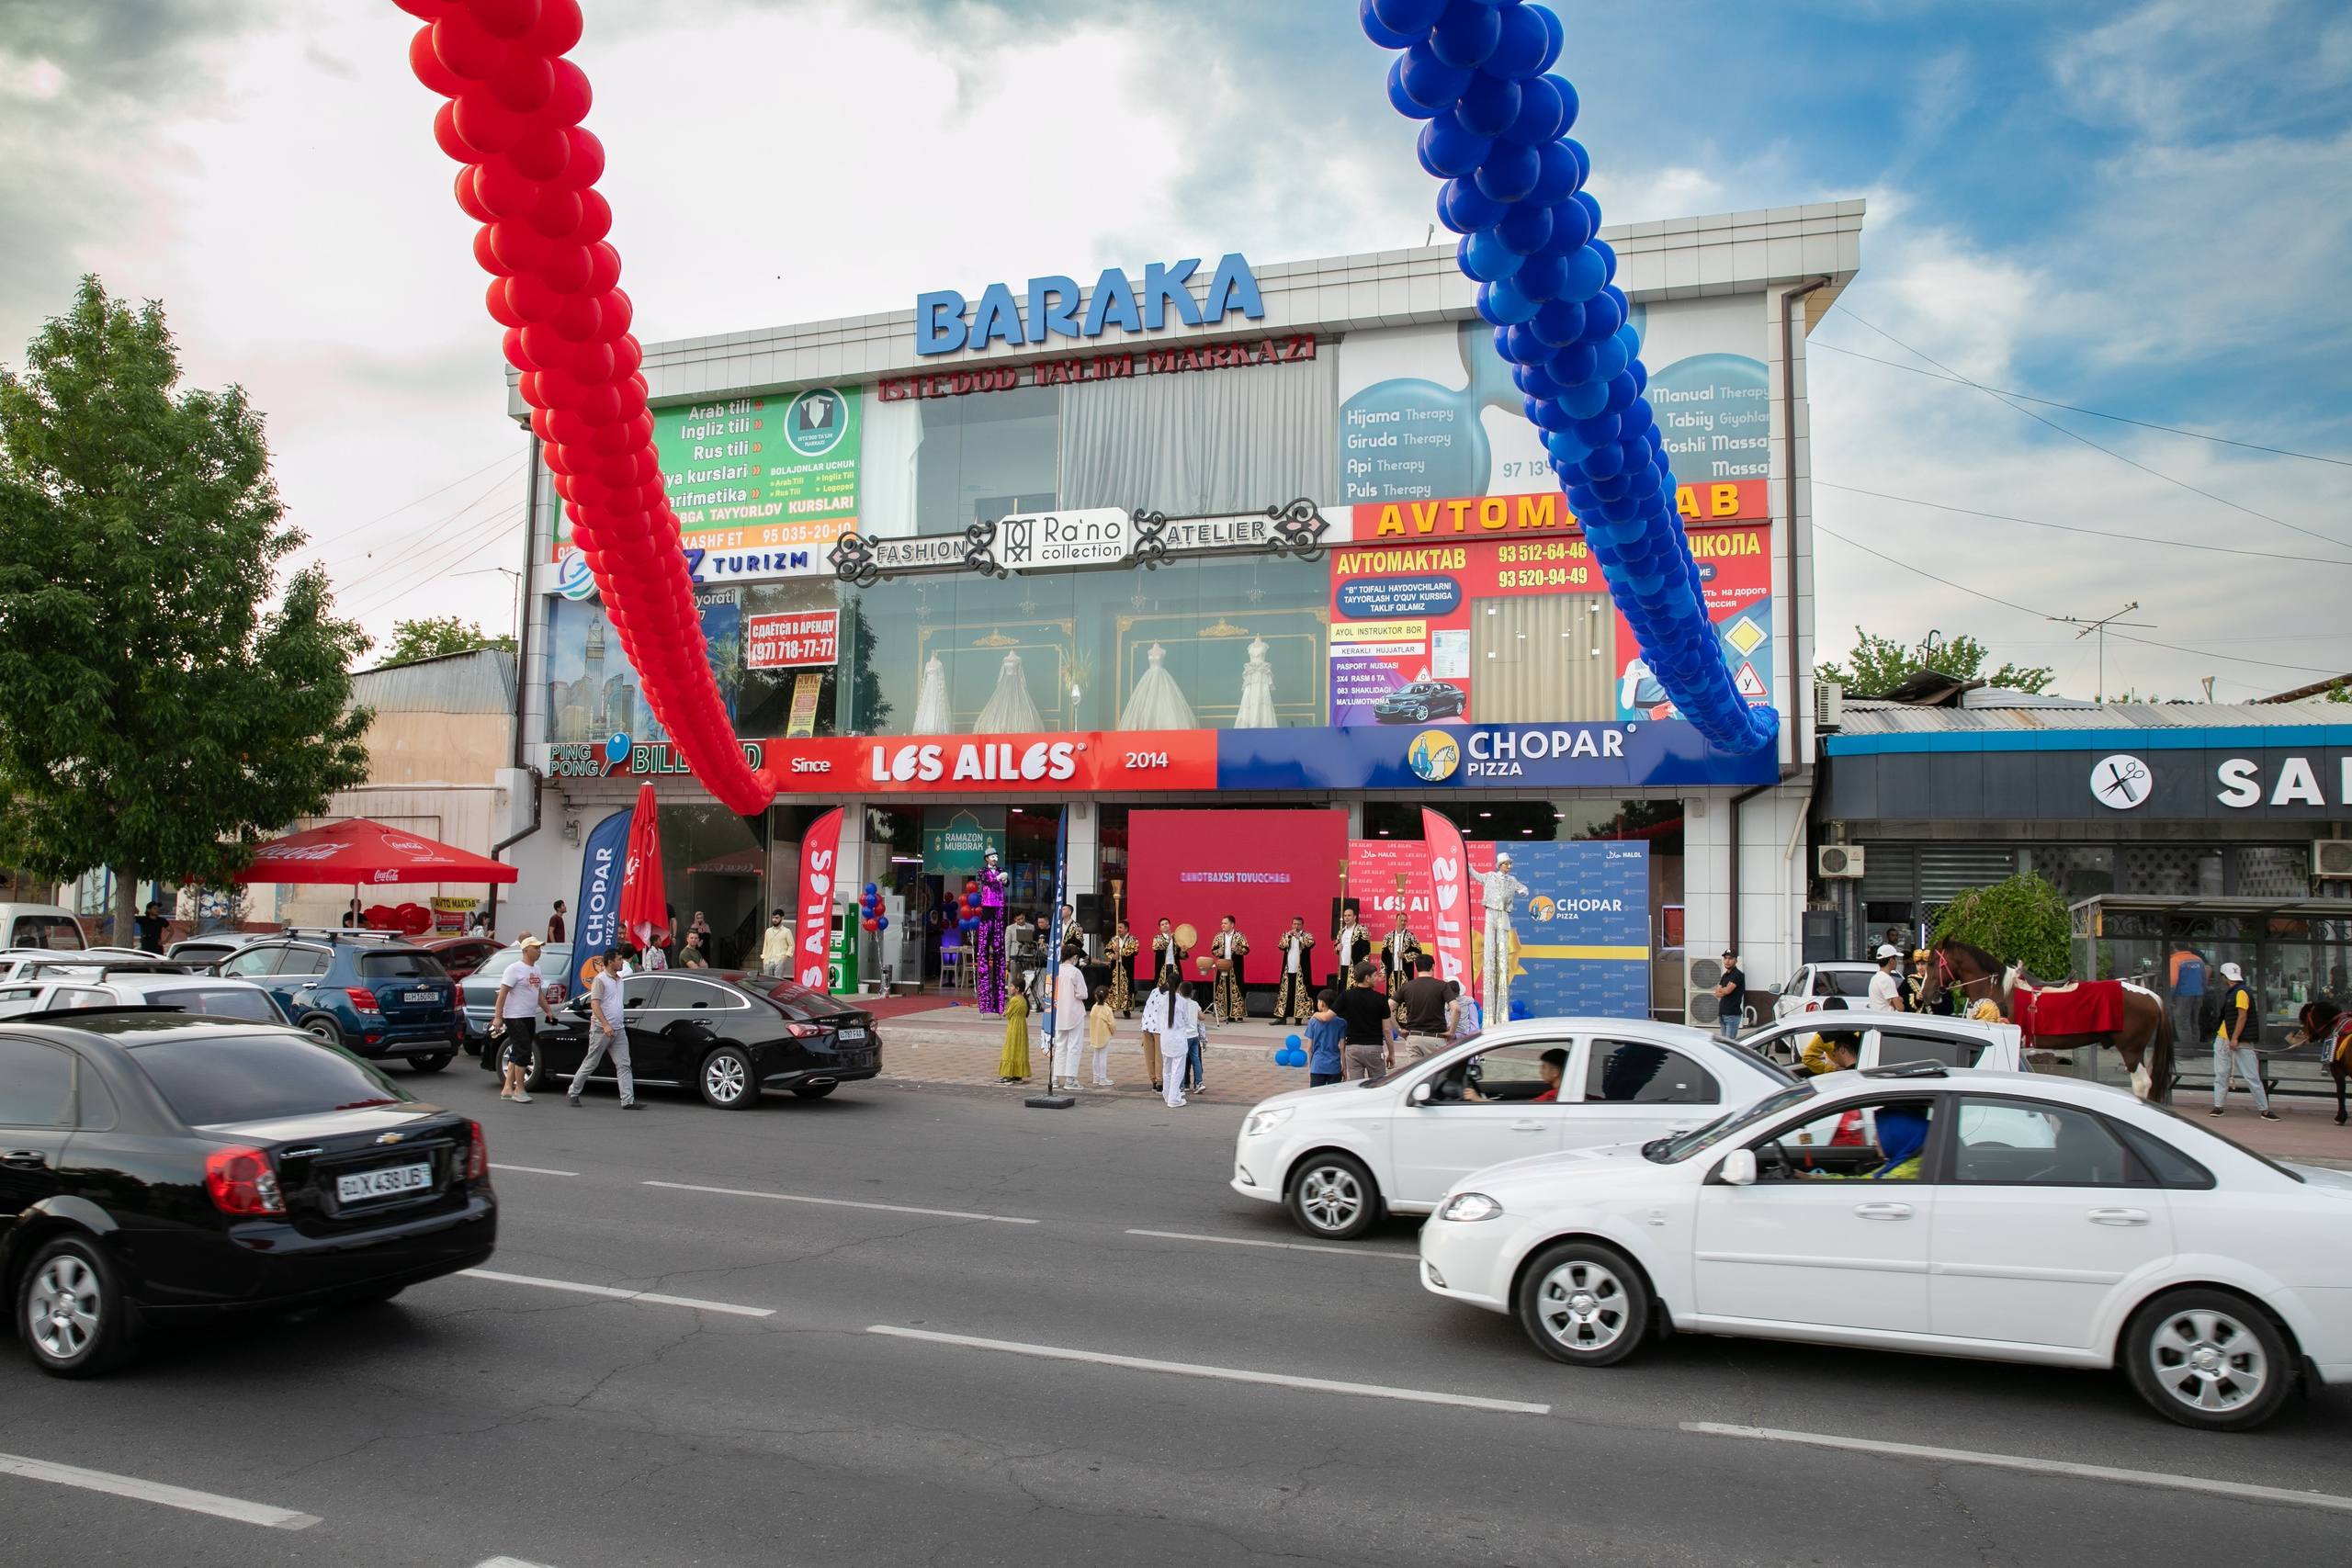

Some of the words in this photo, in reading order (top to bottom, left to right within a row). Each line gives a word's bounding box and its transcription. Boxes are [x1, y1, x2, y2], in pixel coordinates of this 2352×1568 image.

[917, 253, 1265, 356] BARAKA
[1147, 333, 1316, 375] MARKAZI
[1653, 385, 1714, 403] Manual
[1720, 387, 1770, 400] Therapy
[688, 403, 724, 421] Arab
[729, 399, 750, 414] tili
[1347, 406, 1400, 428] Hijama
[1406, 408, 1453, 423] Therapy
[681, 422, 724, 441] Ingliz
[728, 418, 750, 434] tili
[1667, 412, 1713, 431] Tabiiy
[1348, 432, 1396, 448] Giruda
[1403, 434, 1452, 446] Therapy
[1662, 436, 1705, 454] Toshli
[694, 445, 722, 460] Rus
[727, 440, 749, 456] tili
[687, 463, 748, 484] kurslari
[770, 463, 824, 476] BOLAJONLAR
[825, 459, 854, 470] UCHUN
[1347, 457, 1371, 478] Api
[1377, 460, 1424, 473] Therapy
[1503, 462, 1521, 478] 97
[775, 479, 792, 487] Arab
[821, 474, 842, 482] Ingliz
[823, 483, 854, 493] Logoped
[1347, 482, 1378, 498] Puls
[1384, 484, 1430, 498] Therapy
[669, 488, 747, 508] arifmetika
[710, 503, 783, 521] TAYYORLOV
[788, 496, 854, 513] KURSLARI
[729, 532, 743, 546] ET
[763, 528, 778, 543] 95
[783, 522, 851, 540] 035-20-10
[1166, 520, 1266, 544] ATELIER
[876, 540, 967, 563] FASHION
[1042, 543, 1122, 560] collection
[1498, 546, 1516, 562] 93
[1520, 542, 1588, 562] 512-64-46
[713, 551, 808, 573] TURIZM
[1337, 548, 1466, 575] AVTOMAKTAB
[1498, 570, 1516, 588] 93
[1519, 567, 1588, 587] 520-94-49
[1389, 582, 1452, 592] HAYDOVCHILARNI
[1735, 587, 1767, 597] дороге
[1344, 595, 1389, 604] TAYYORLASH
[1420, 592, 1452, 601] KURSIGA
[1396, 603, 1426, 612] QILAMIZ
[752, 622, 791, 637] СДАЁТСЯ
[793, 623, 798, 634] В
[800, 620, 834, 634] АРЕНДУ
[1358, 626, 1402, 636] INSTRUKTOR
[752, 642, 775, 661] (97)
[778, 638, 833, 660] 718-77-77
[549, 744, 592, 761] PING
[1467, 729, 1624, 761] CHOPAR
[632, 743, 761, 774] BILLD
[791, 757, 831, 773] Since
[1125, 751, 1169, 770] 2014
[549, 761, 599, 776] PONG
[1467, 762, 1523, 777] PIZZA
[944, 841, 983, 851] MUBORAK
[945, 833, 983, 841] RAMAZON
[435, 899, 450, 908] AVTO
[452, 899, 476, 908] MAKTAB
[586, 849, 612, 946] CHOPAR
[1556, 898, 1622, 911] CHOPAR
[606, 911, 615, 945] PIZZA
